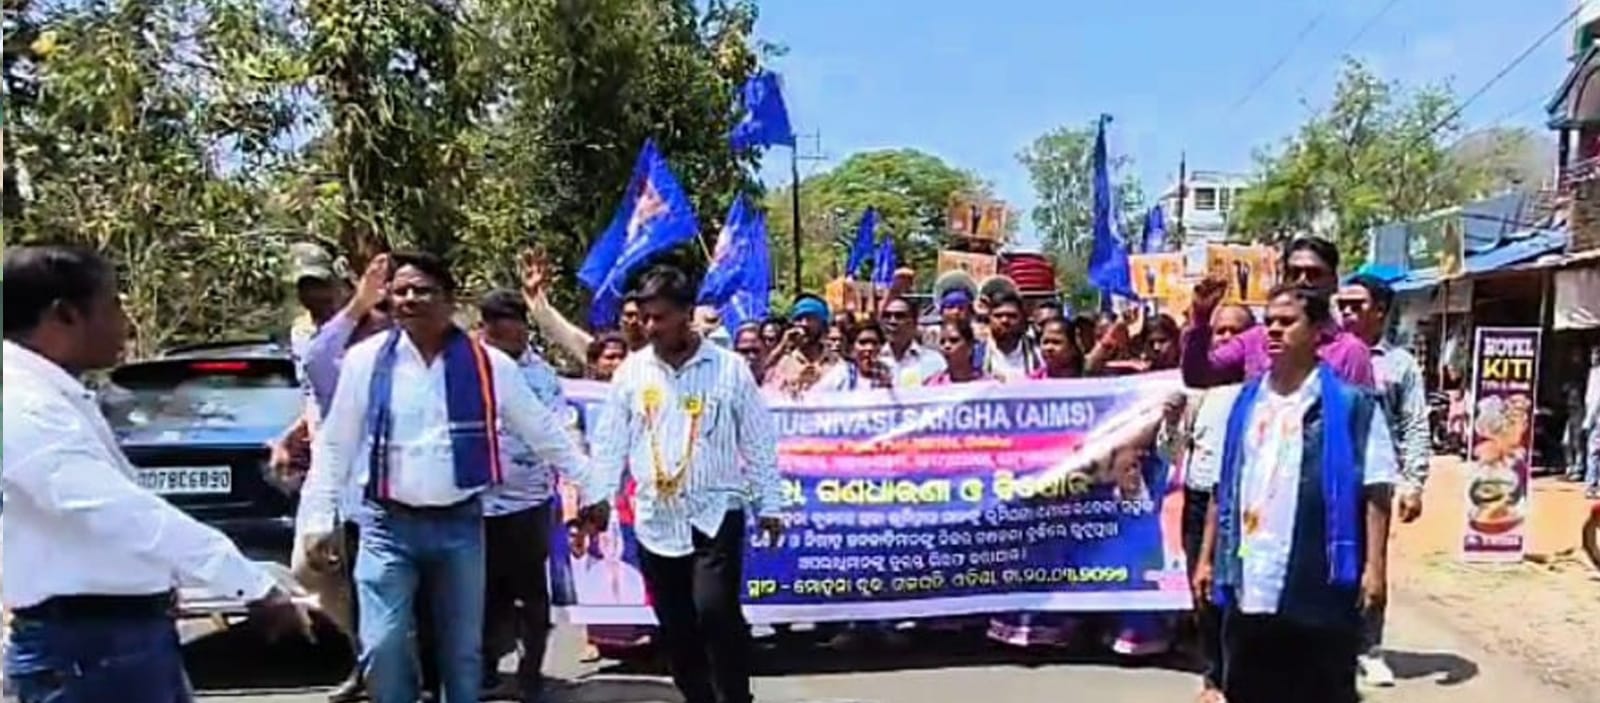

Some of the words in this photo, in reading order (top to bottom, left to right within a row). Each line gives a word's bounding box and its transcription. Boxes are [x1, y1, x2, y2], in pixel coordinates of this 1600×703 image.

[1482, 358, 1533, 379] KITI
[899, 403, 1010, 431] SANGHA
[1015, 401, 1095, 429] (AIMS)
